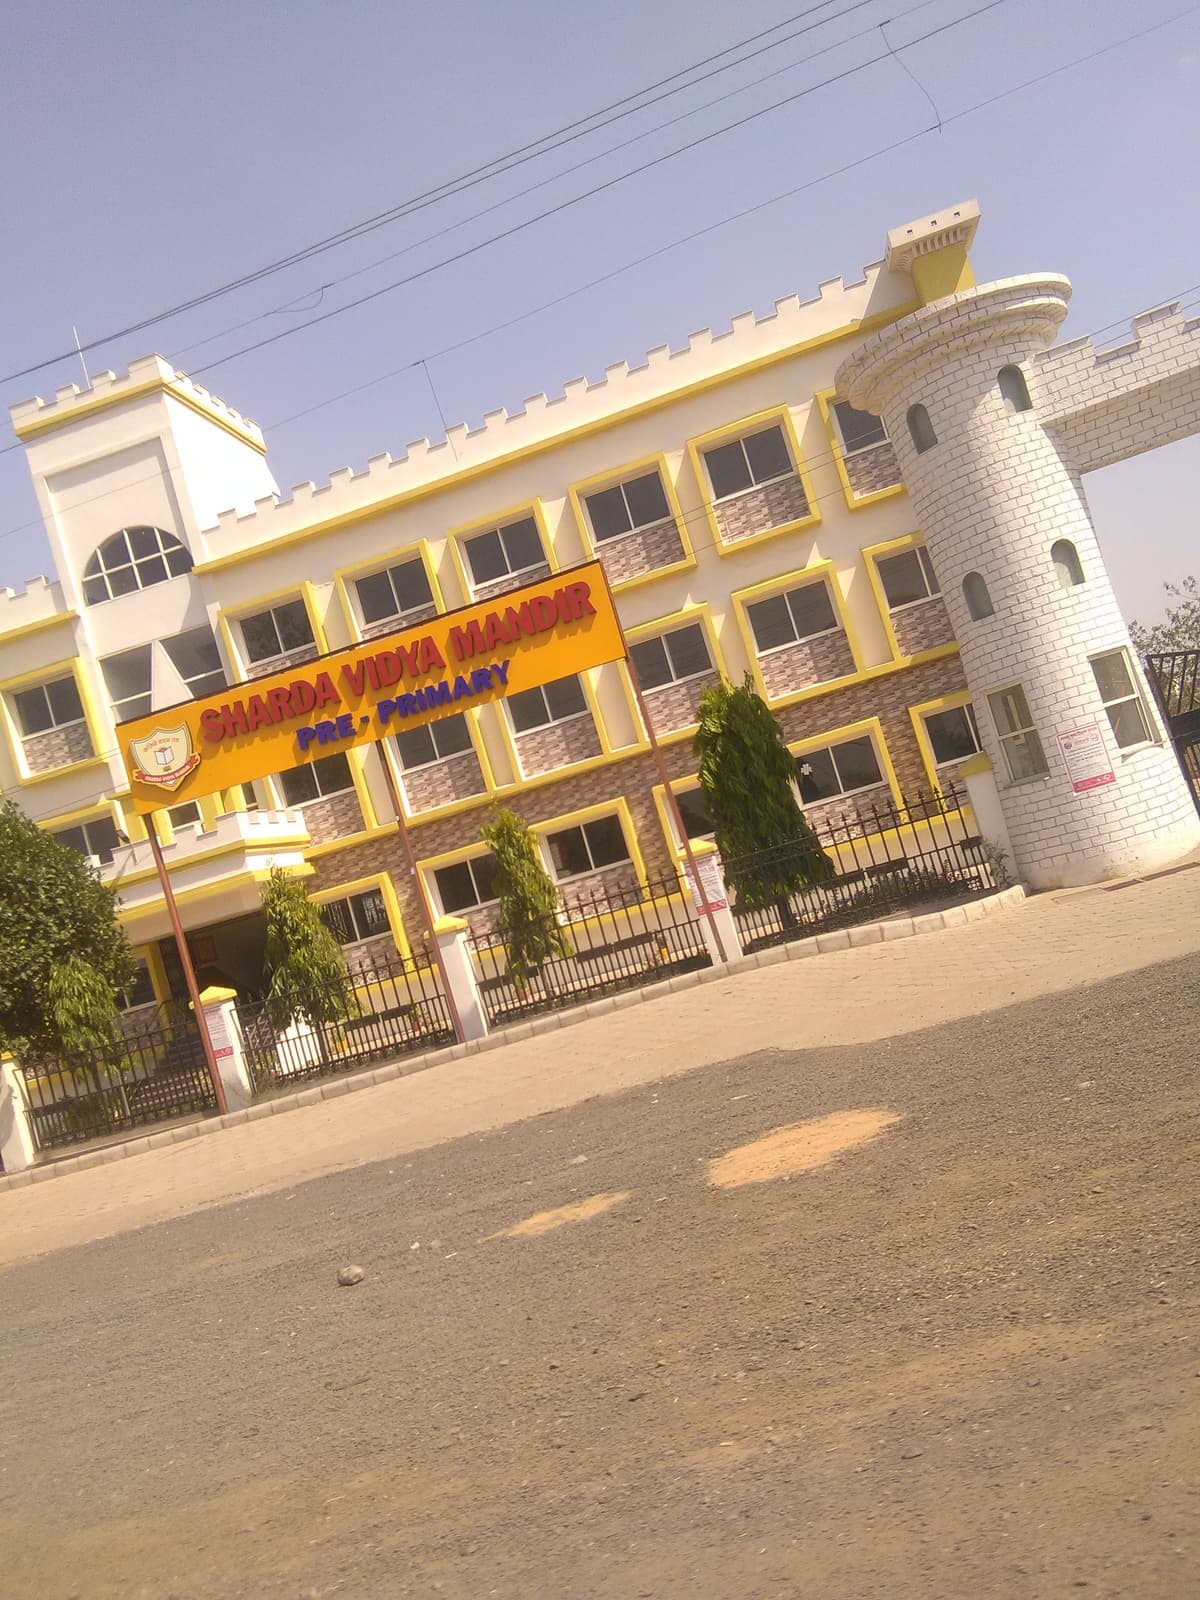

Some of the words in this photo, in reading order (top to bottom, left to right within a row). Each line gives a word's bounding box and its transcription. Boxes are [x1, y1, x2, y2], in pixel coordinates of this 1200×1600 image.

[200, 671, 340, 744] SHARDA
[342, 640, 446, 698] VIDYA
[449, 581, 597, 663] MANDIR
[298, 713, 356, 750] PRE
[377, 660, 511, 723] PRIMARY
